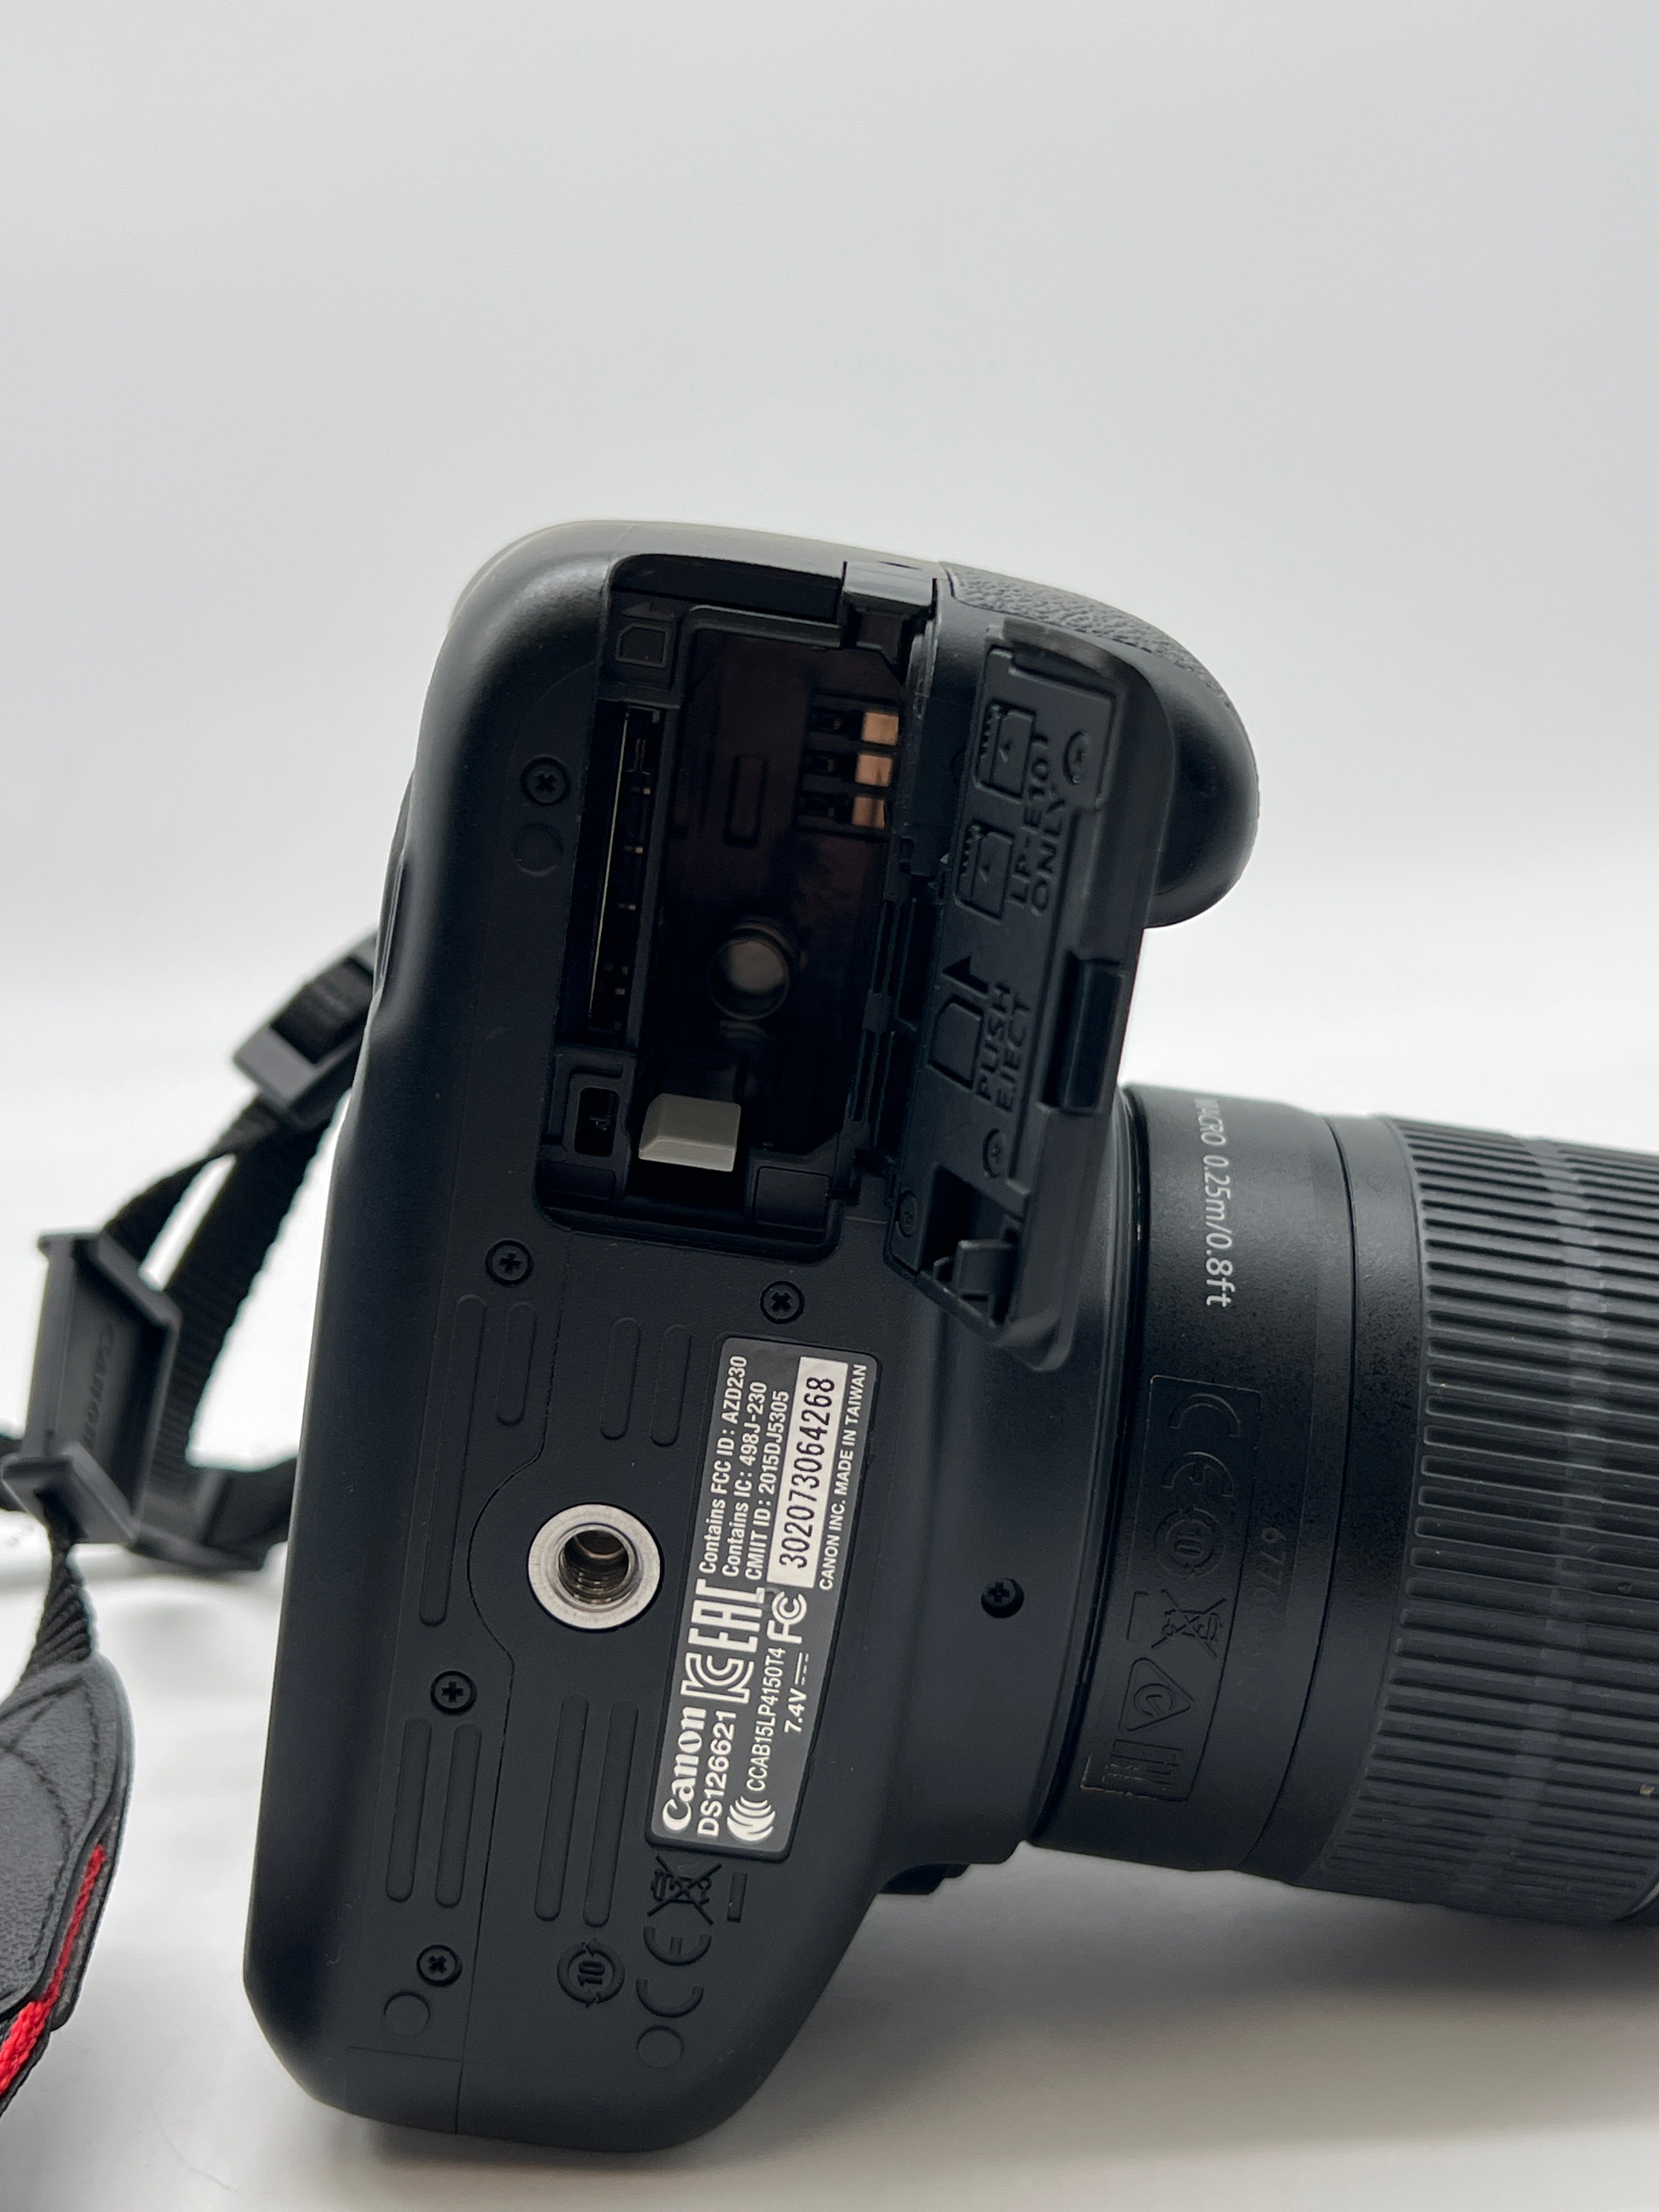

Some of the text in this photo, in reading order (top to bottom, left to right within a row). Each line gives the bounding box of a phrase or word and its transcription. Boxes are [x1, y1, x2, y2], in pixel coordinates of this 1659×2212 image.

[1032, 785, 1065, 916] ONLY
[974, 981, 1011, 1101] PUSH
[994, 991, 1030, 1113] EJECT
[1203, 1155, 1235, 1307] 0.25m/0.8ft
[699, 1356, 748, 1573] Contains FCC ID: AZD230
[722, 1381, 767, 1577] Contains IC: 498J-230
[745, 1391, 789, 1581] CMIIT ID: 2015DJ5305
[778, 1377, 836, 1569] 302073064268
[820, 1363, 867, 1590] CANON INC. MADE IN TAIWAN
[662, 1706, 707, 1831] Canon
[697, 1710, 737, 1837] DS126621
[746, 1646, 786, 1792] CCAB15LP4150T4
[785, 1688, 808, 1733] 7.4V
